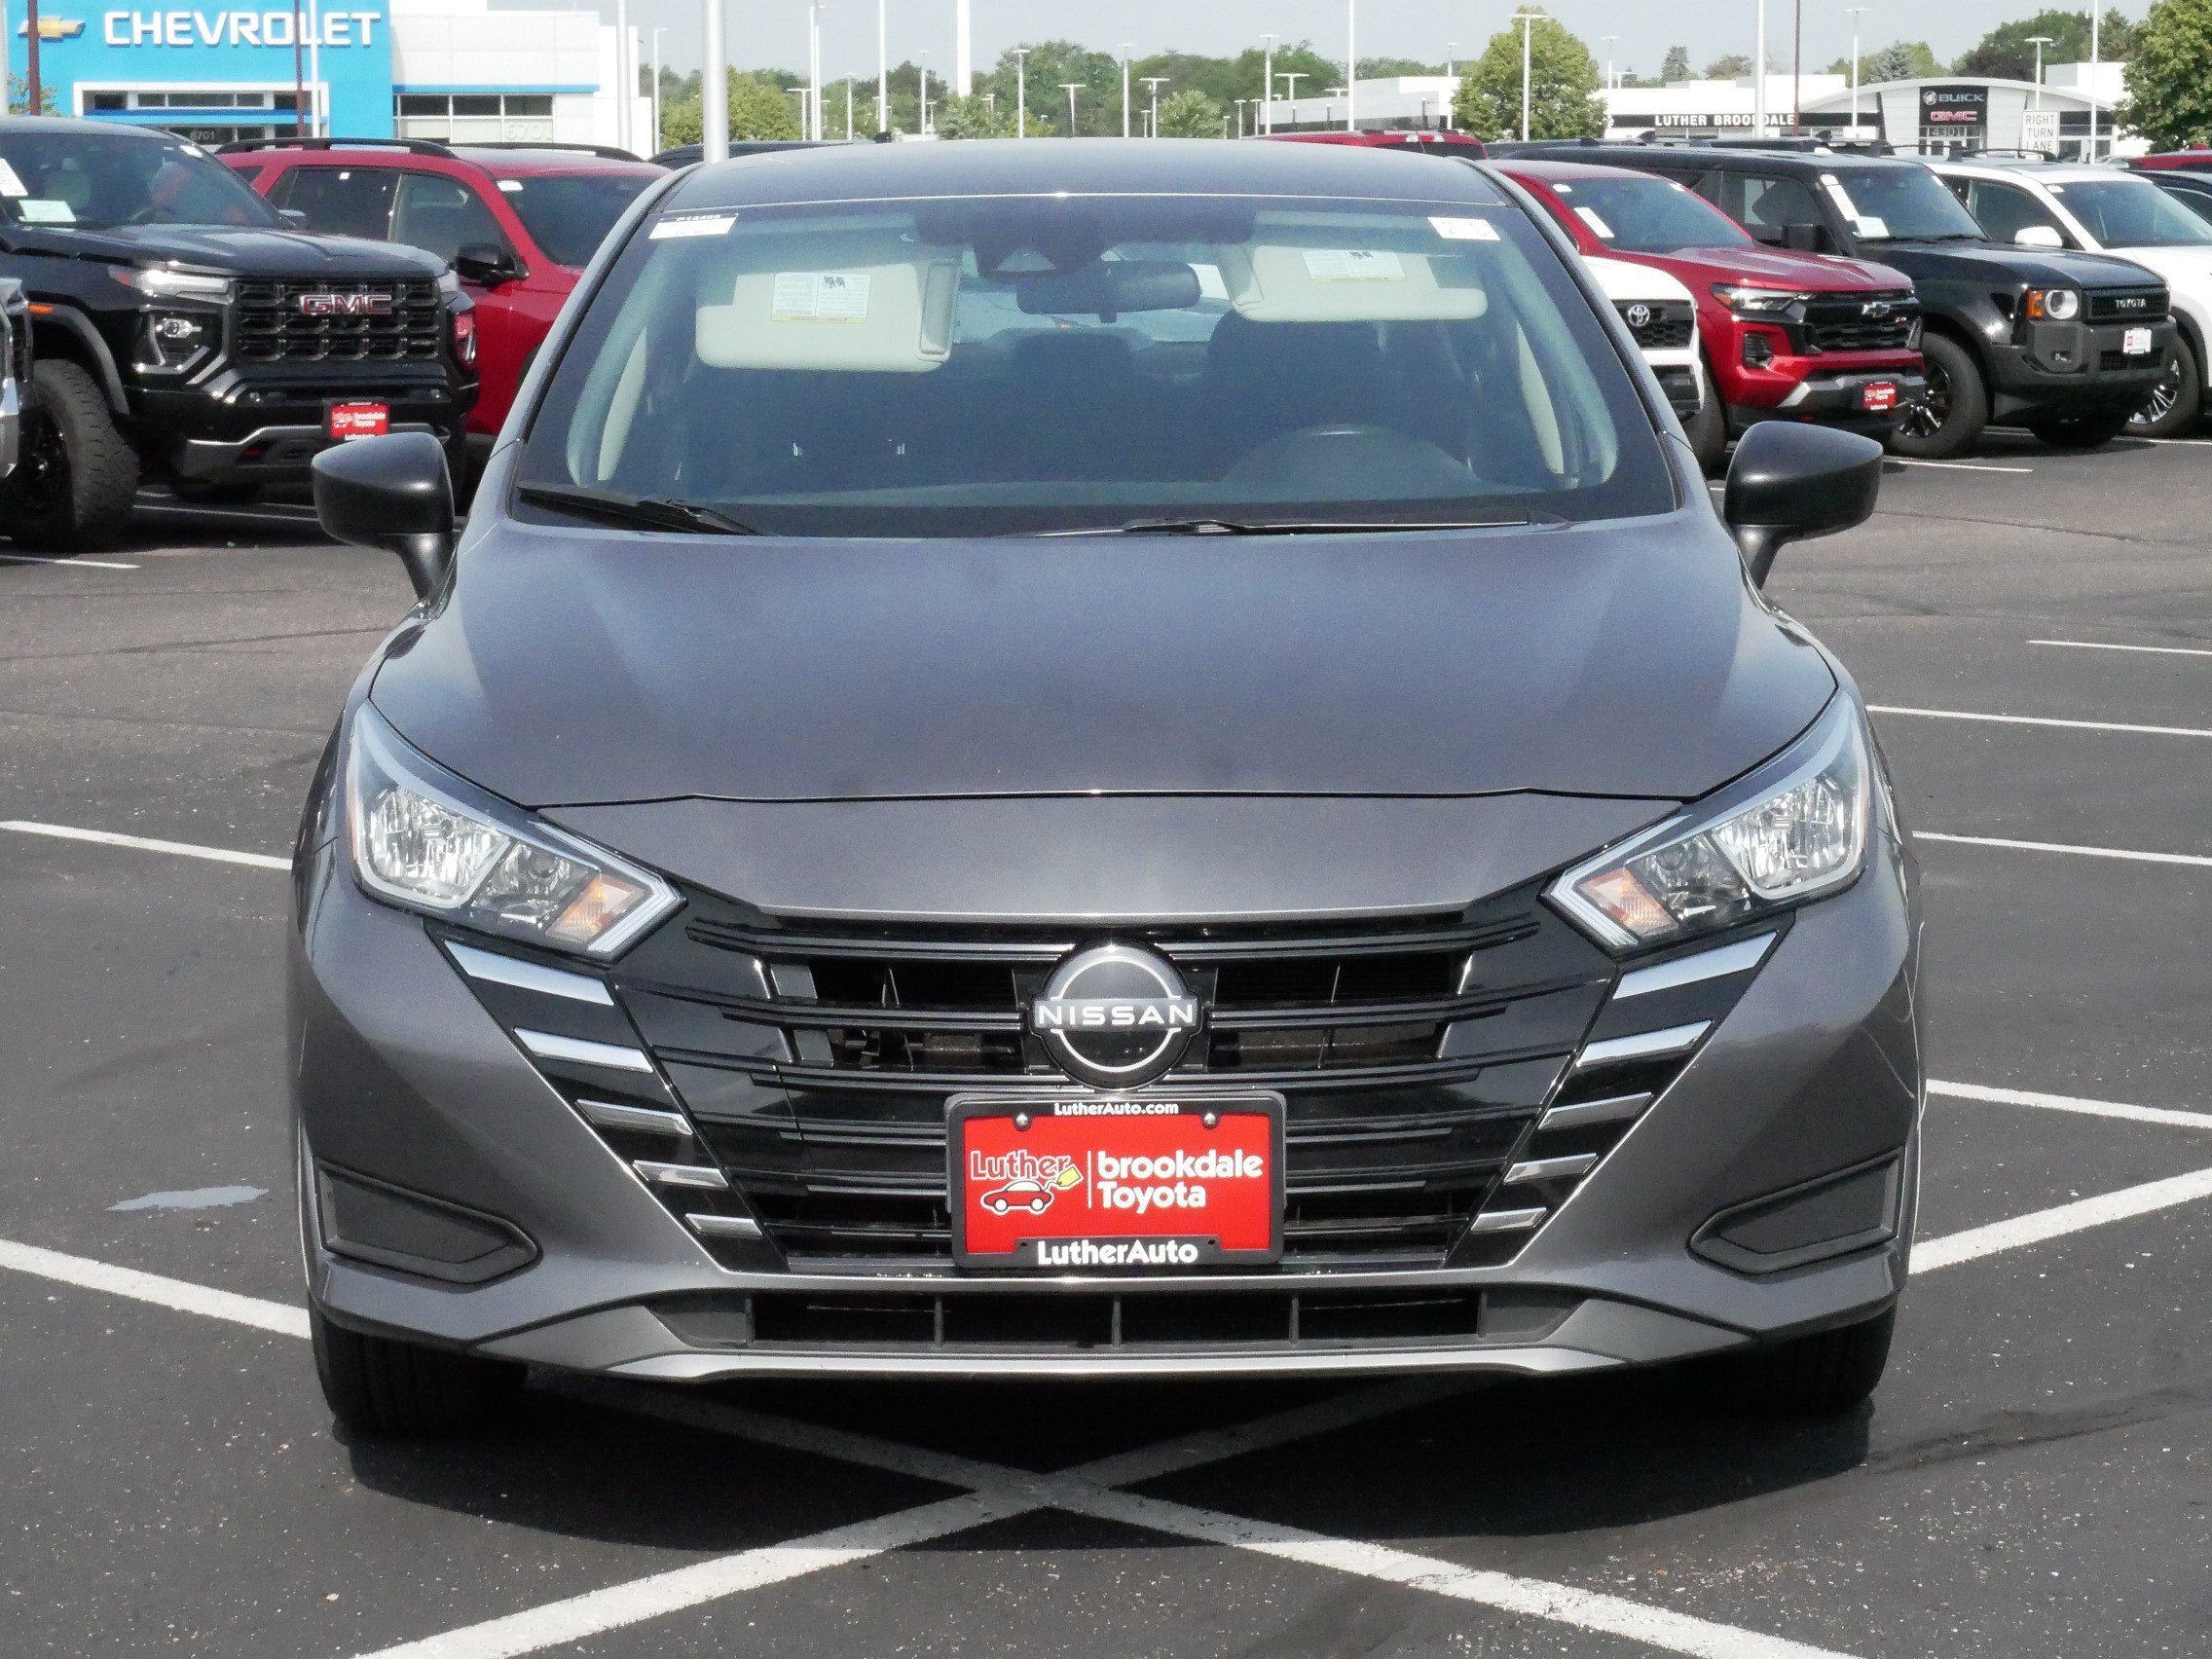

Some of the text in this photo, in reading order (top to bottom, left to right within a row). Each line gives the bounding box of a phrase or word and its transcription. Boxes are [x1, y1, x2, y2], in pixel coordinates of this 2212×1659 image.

[104, 12, 382, 46] CHEVROLET
[1938, 93, 1985, 102] BUICK
[1655, 114, 1795, 126] LUTHER BROODALE
[1930, 110, 1978, 122] GMC
[2025, 115, 2055, 125] RIGHT
[2027, 128, 2053, 137] TURN
[2026, 141, 2052, 151] LANE
[299, 294, 391, 314] GMC
[2115, 298, 2147, 309] TOYOTA
[1039, 1004, 1194, 1026] NISSAN
[1054, 1102, 1179, 1117] LutherAuto.com
[970, 1149, 1264, 1181] Luther brookdale
[1096, 1181, 1207, 1214] Toyota
[1037, 1239, 1198, 1266] LutherAuto
